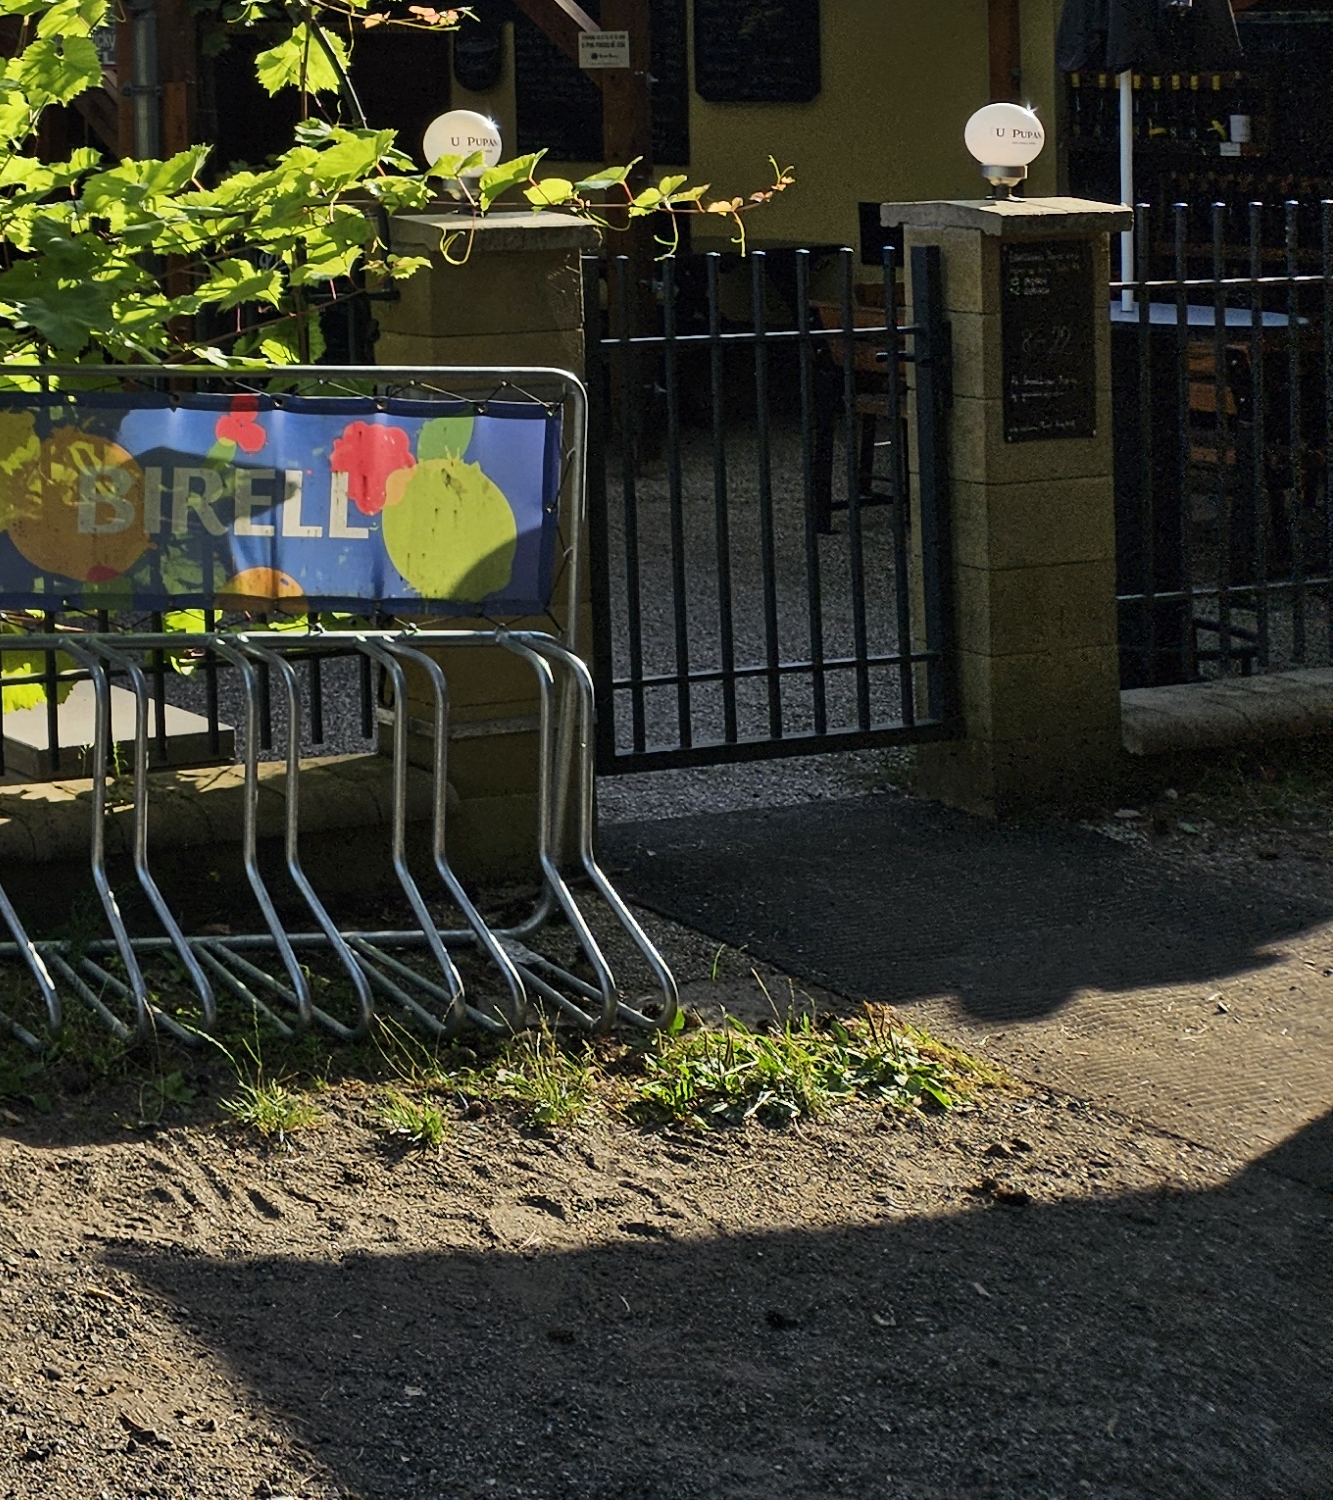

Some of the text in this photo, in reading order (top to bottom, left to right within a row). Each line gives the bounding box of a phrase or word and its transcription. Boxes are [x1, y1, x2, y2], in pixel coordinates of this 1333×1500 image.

[996, 128, 1005, 137] U
[450, 136, 460, 147] U
[77, 465, 370, 539] BIRELL
